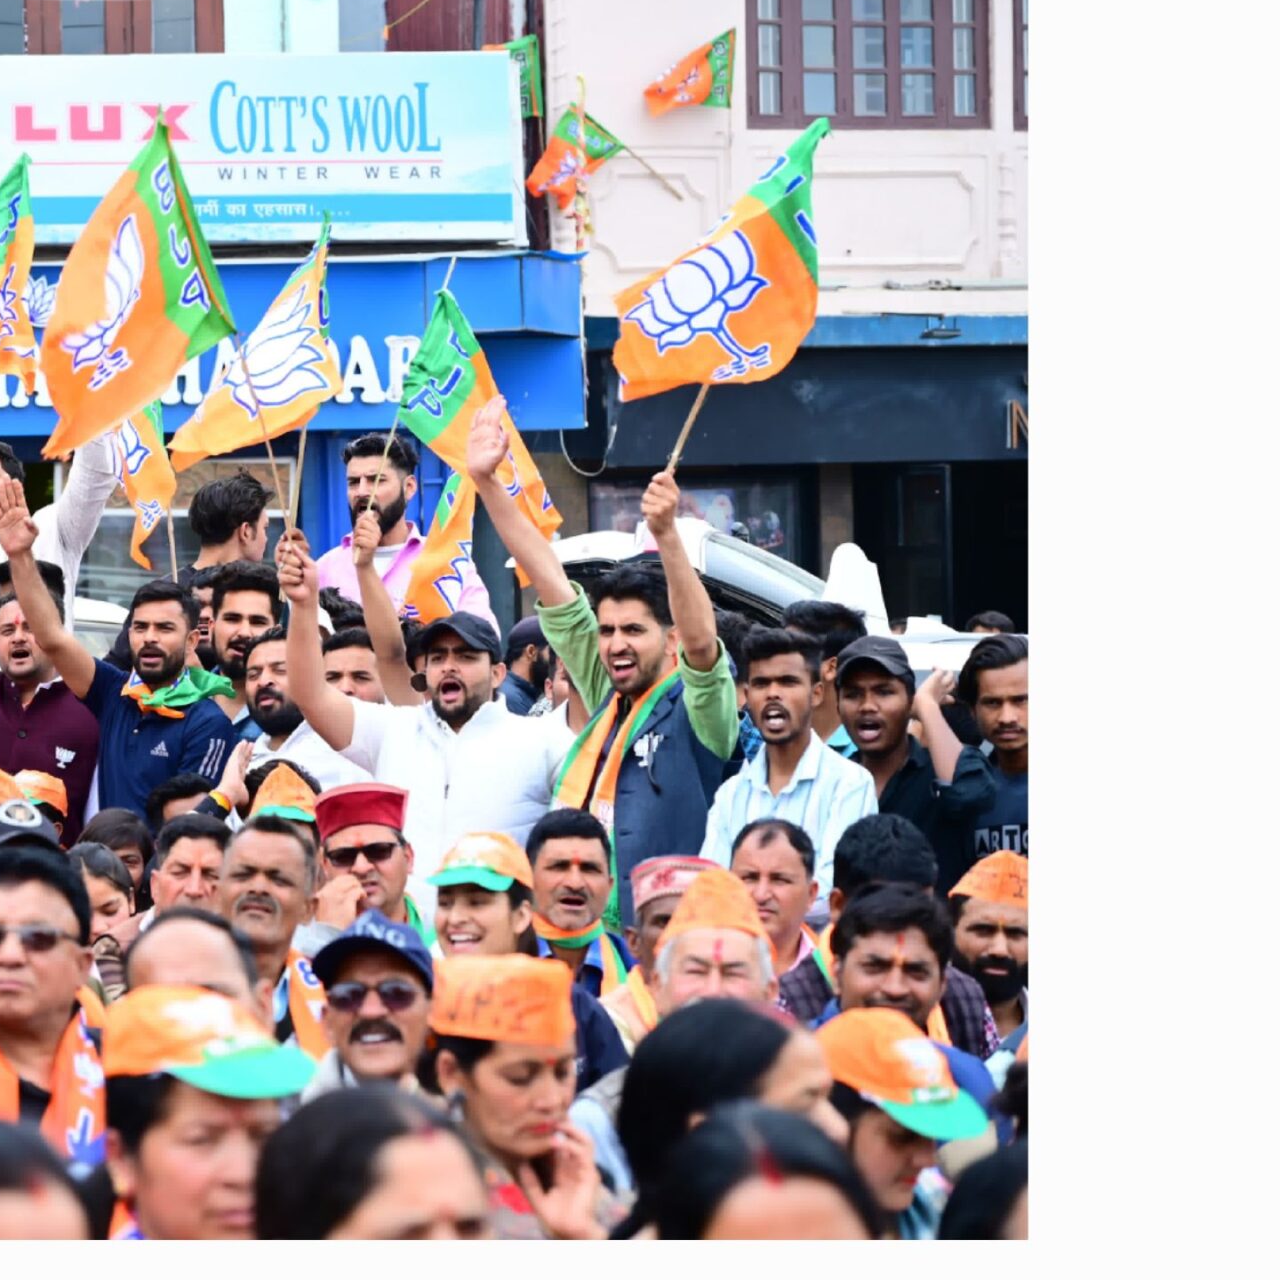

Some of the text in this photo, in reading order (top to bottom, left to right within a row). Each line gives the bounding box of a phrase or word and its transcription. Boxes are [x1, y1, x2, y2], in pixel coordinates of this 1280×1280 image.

[14, 104, 192, 142] LUX
[217, 165, 442, 181] WINTER WEAR
